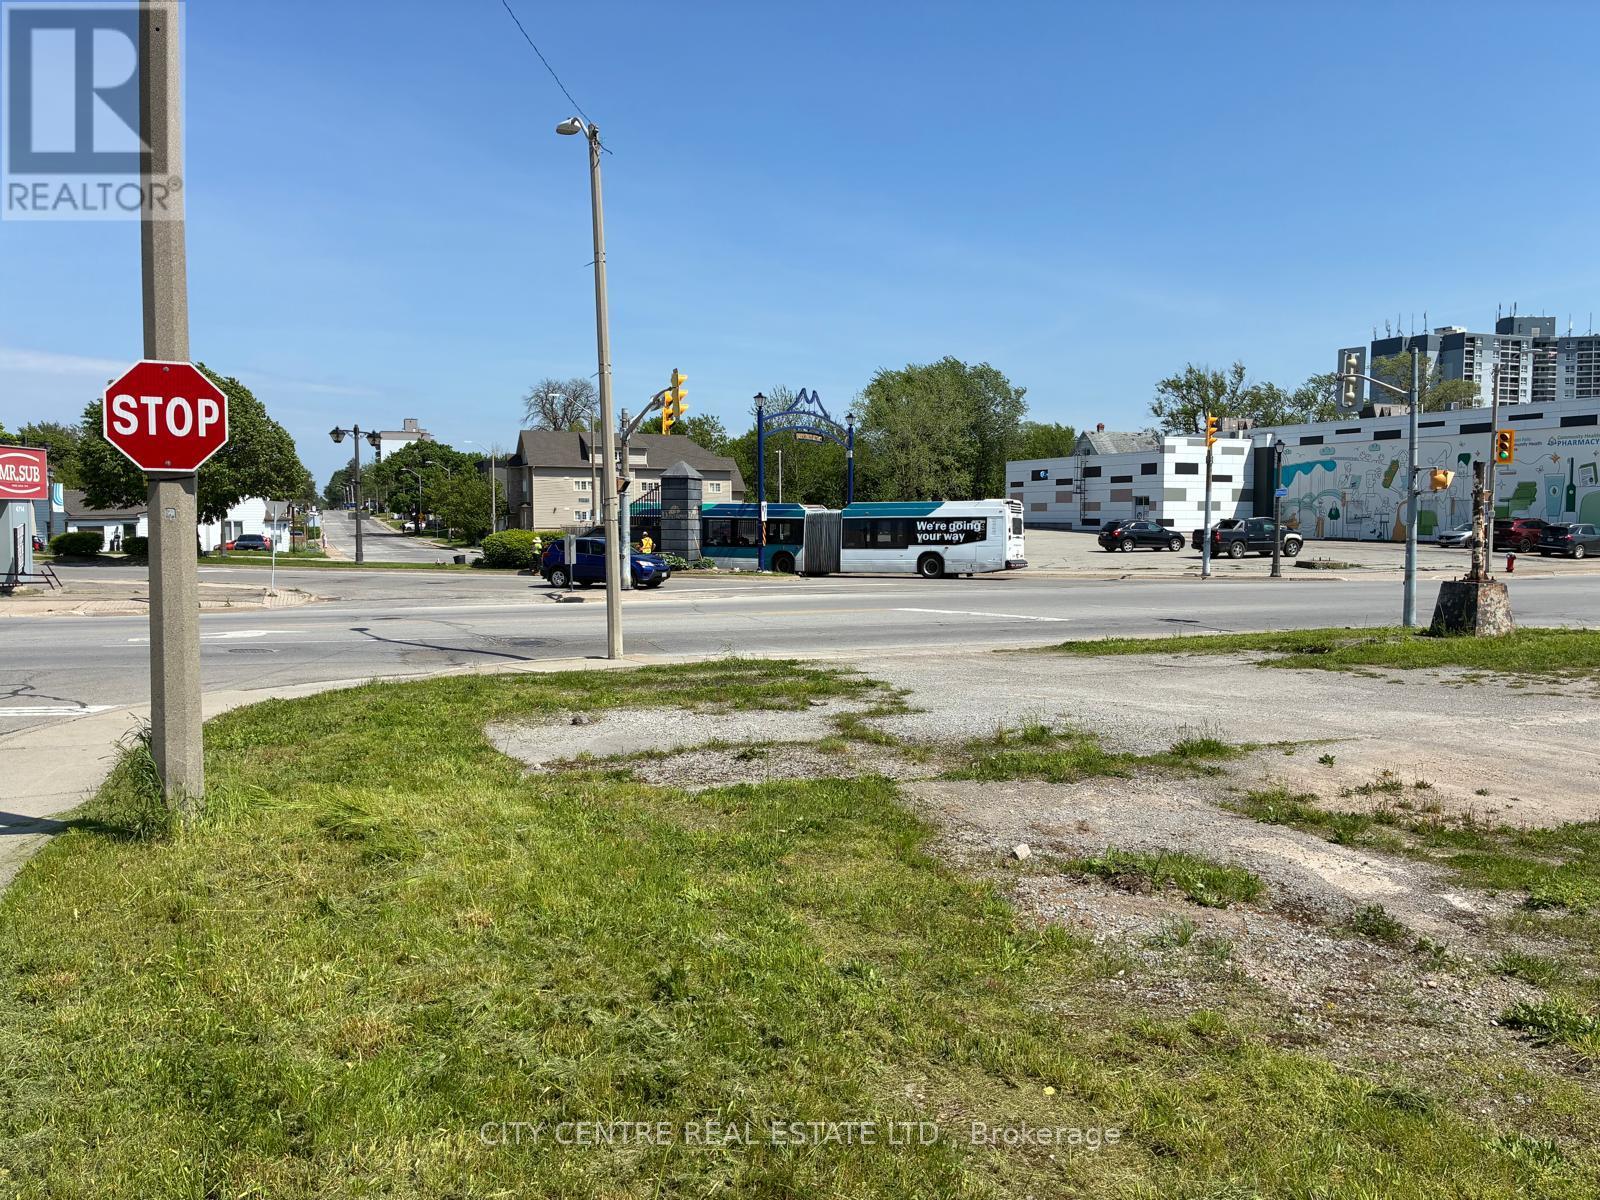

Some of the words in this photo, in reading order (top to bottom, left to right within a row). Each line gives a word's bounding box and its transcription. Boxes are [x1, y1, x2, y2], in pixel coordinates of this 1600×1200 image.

[112, 394, 220, 437] STOP
[0, 464, 40, 483] MR.SUB
[916, 521, 947, 531] We're
[949, 521, 981, 532] going
[917, 532, 942, 543] your
[944, 532, 965, 542] way
